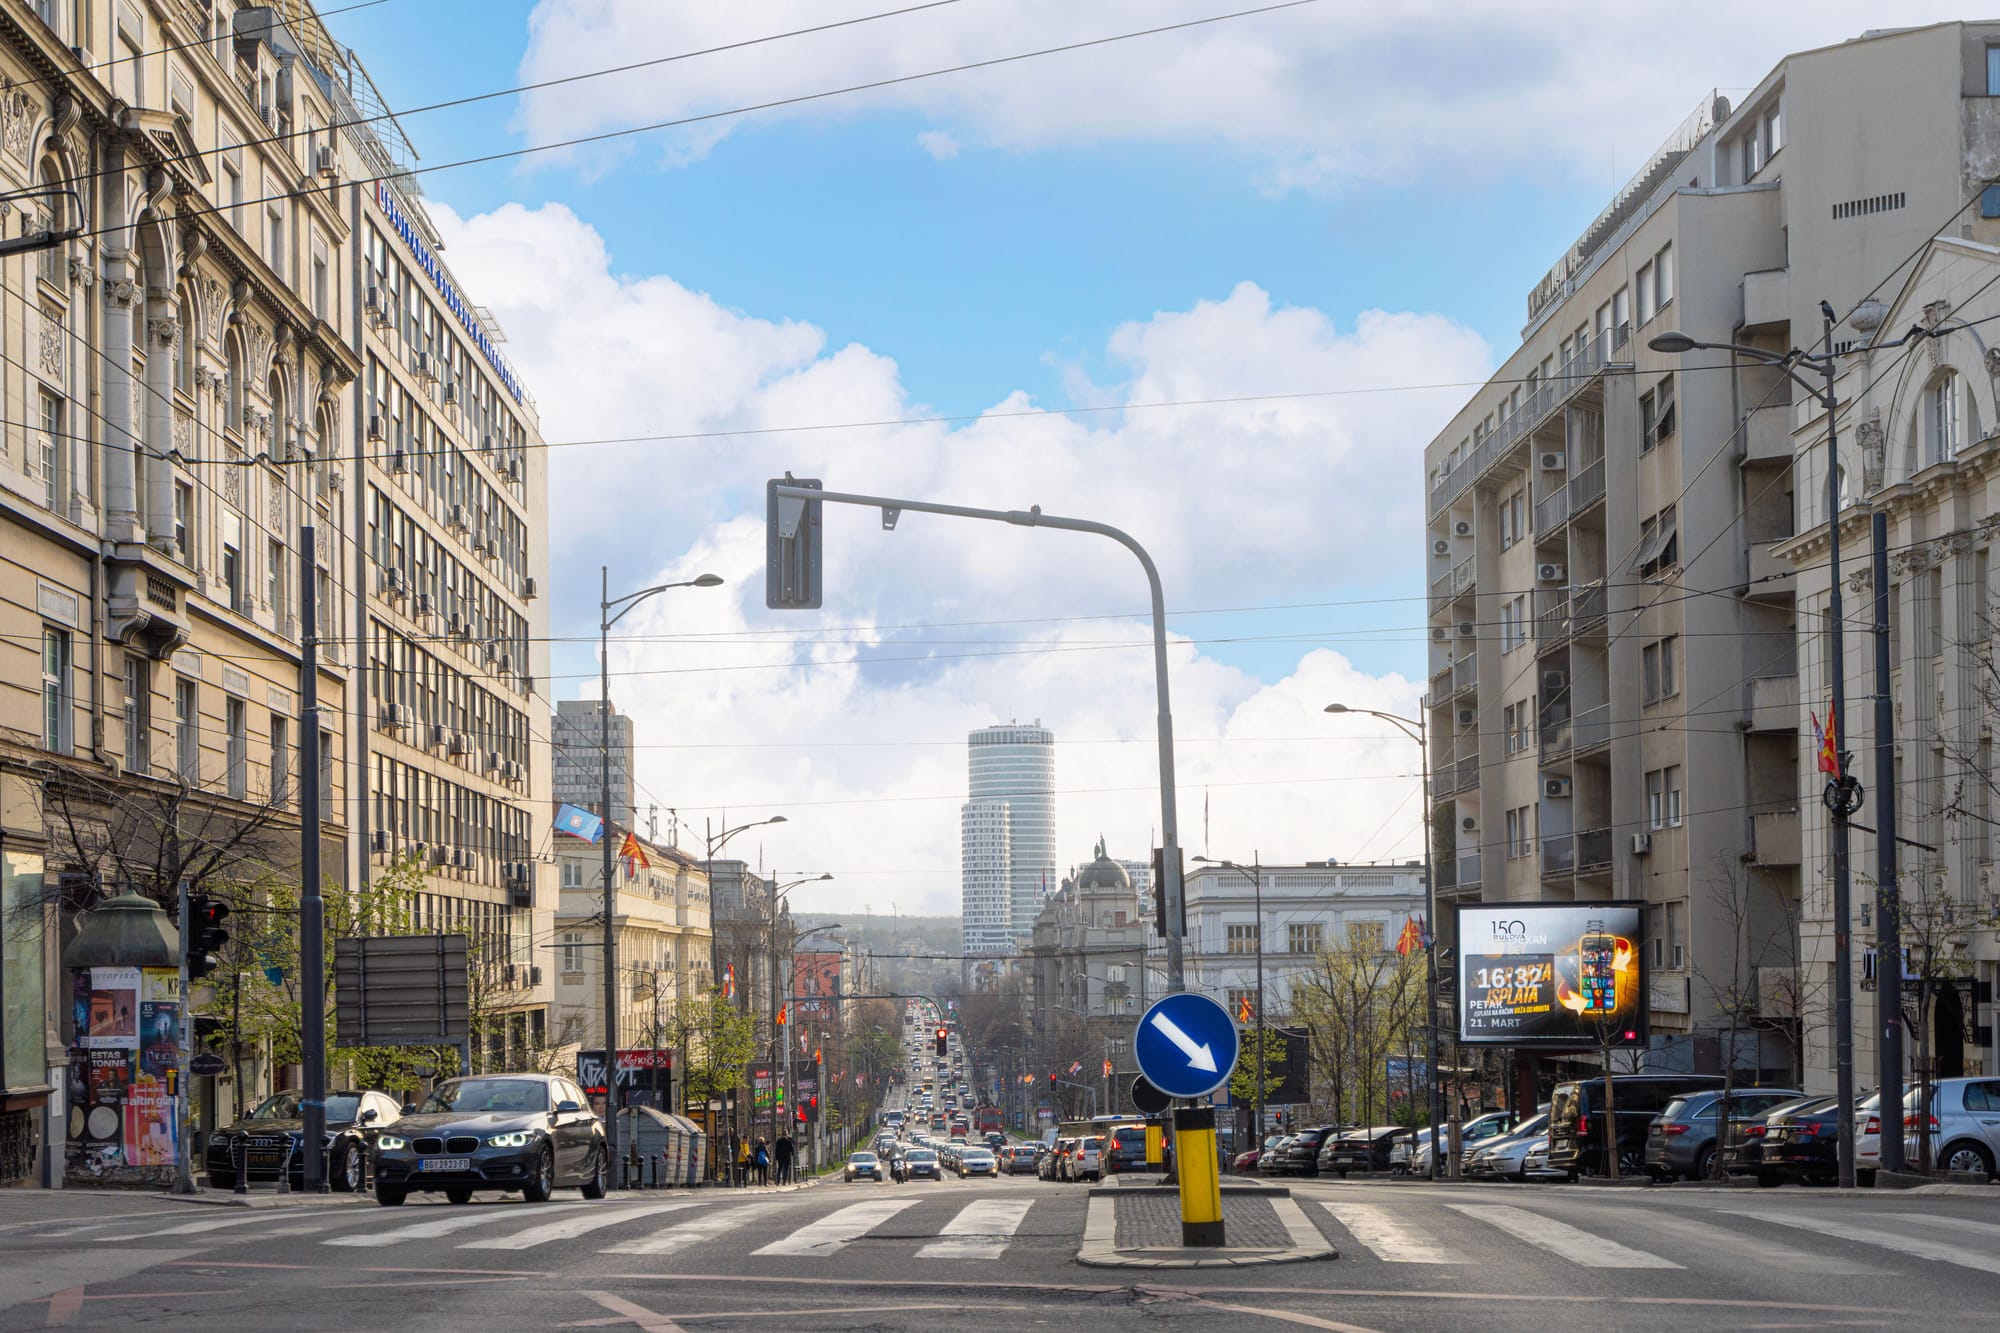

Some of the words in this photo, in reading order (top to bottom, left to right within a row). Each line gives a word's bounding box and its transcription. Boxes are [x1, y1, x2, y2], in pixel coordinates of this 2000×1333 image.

[1491, 920, 1526, 934] 150
[1477, 967, 1543, 989] 16:32
[1486, 985, 1539, 1008] ISPLATA
[1470, 1000, 1503, 1009] PETAK
[1470, 1018, 1487, 1028] 21.
[1491, 1018, 1521, 1028] MART
[91, 1051, 121, 1060] ESTAS
[91, 1059, 127, 1068] TONNE
